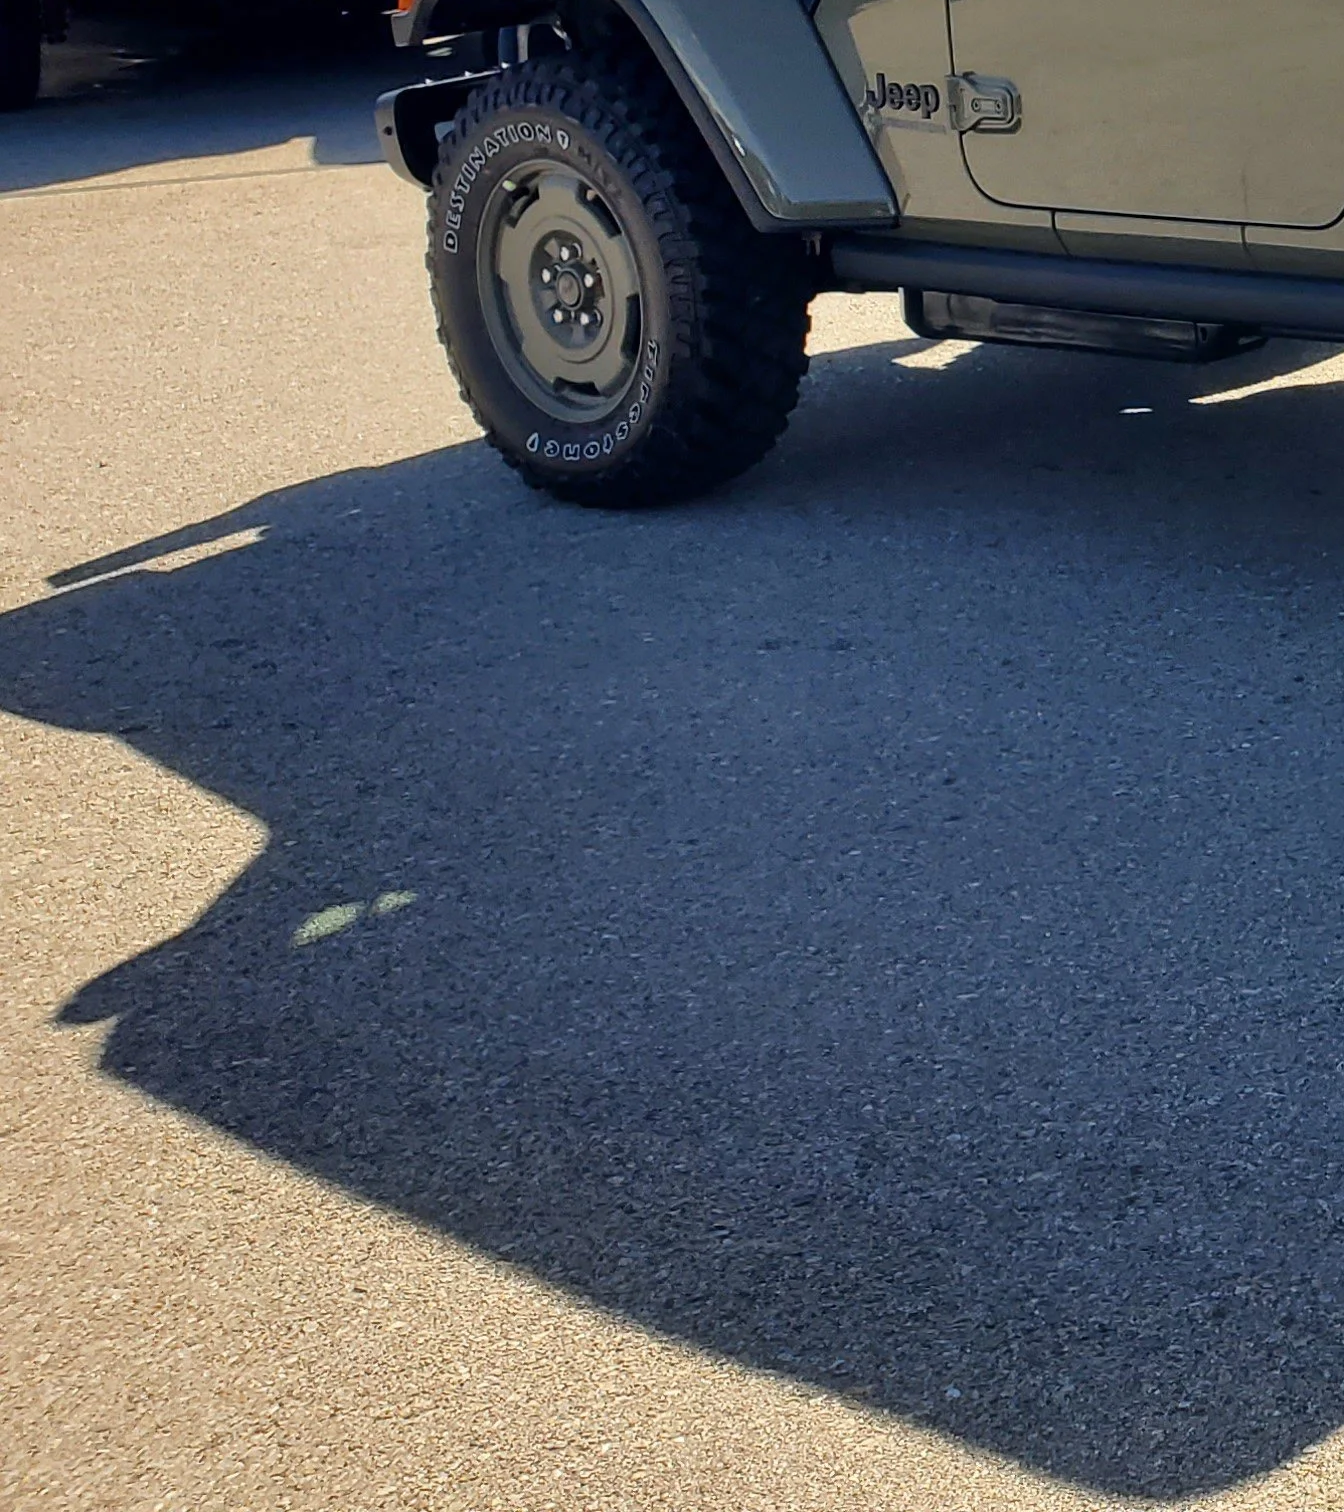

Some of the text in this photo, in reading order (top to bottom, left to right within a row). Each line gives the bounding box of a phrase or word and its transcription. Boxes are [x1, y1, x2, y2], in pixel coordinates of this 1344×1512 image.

[866, 72, 940, 120] Jeep
[443, 121, 552, 254] DESTINATION
[543, 339, 658, 461] Firestone
